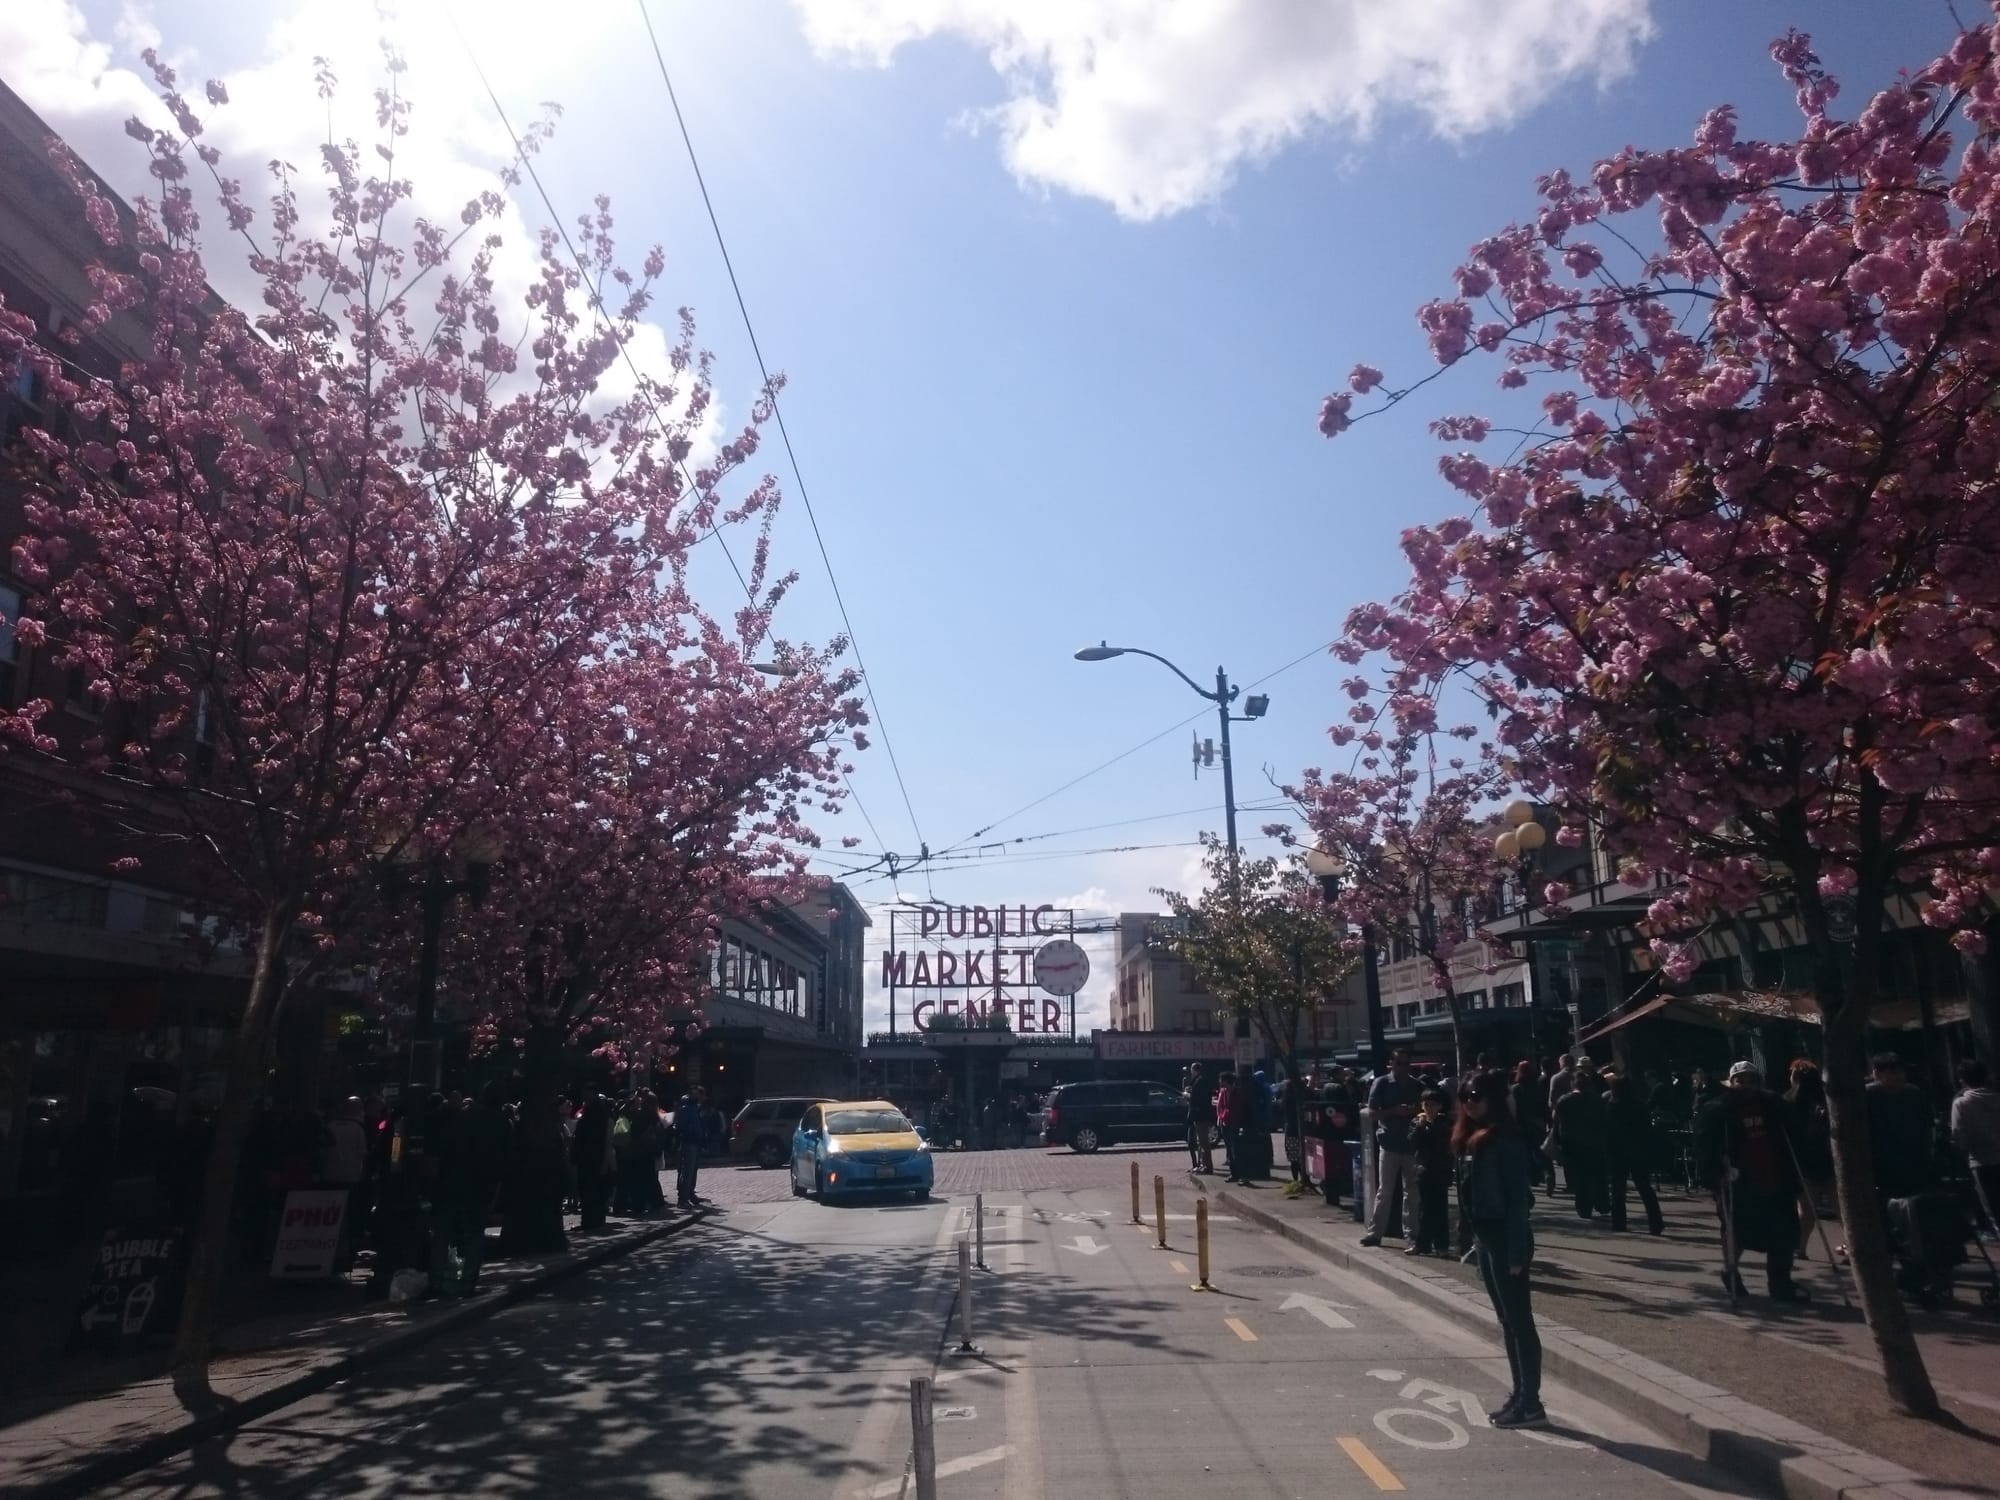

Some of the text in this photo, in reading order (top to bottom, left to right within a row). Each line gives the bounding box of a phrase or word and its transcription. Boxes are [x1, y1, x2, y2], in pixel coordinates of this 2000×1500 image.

[921, 904, 1054, 938] PUBLIC
[882, 950, 1034, 988] MARKET
[1108, 1040, 1184, 1057] FARMERS
[101, 1239, 174, 1264] BUBBLE
[104, 1259, 143, 1280] TEA
